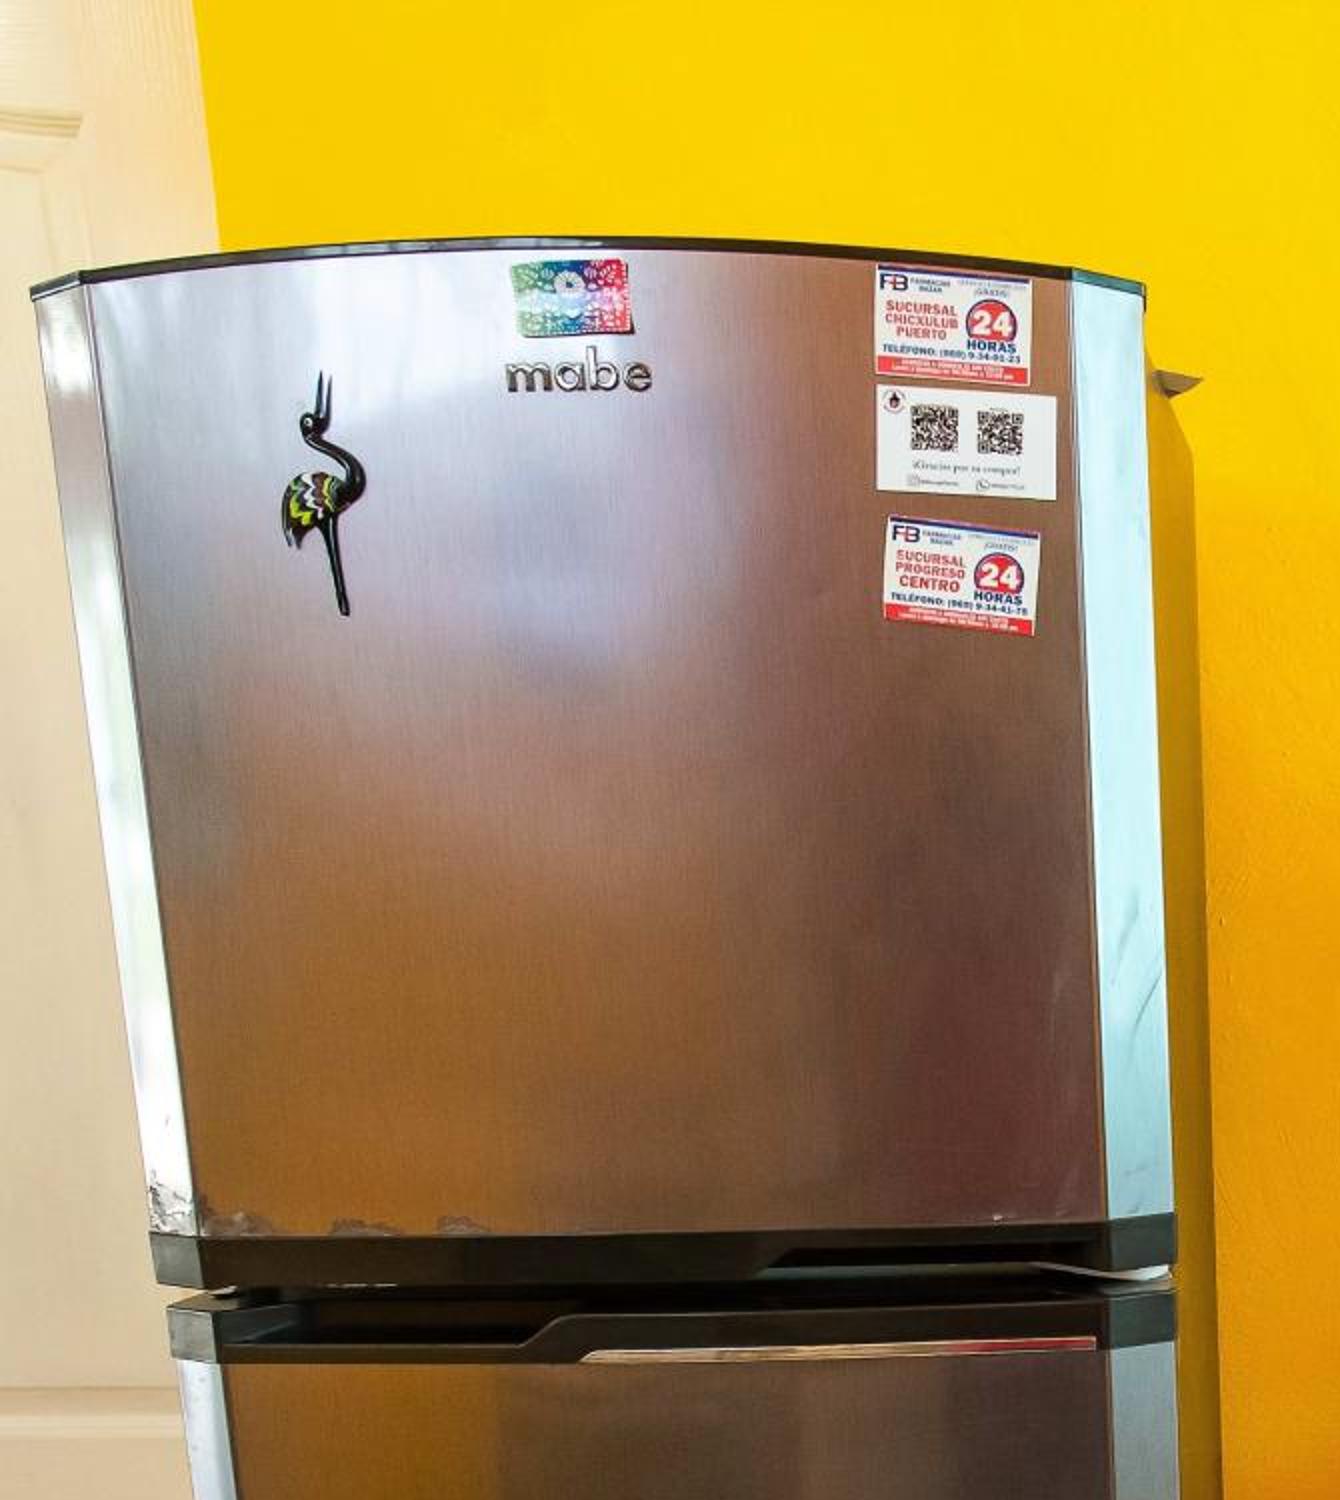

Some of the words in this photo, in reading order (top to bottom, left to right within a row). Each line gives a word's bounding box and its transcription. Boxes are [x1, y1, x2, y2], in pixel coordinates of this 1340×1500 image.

[880, 273, 908, 291] FB
[886, 300, 959, 317] SUCURSAL
[885, 313, 959, 330] CHICXULUB
[972, 309, 1014, 337] 24
[896, 327, 947, 341] PUERTO
[967, 340, 1017, 354] HORAS
[506, 345, 652, 392] mabe
[892, 525, 920, 543] FB
[896, 549, 966, 568] SUCURSAL
[895, 562, 965, 580] PROGRESO
[979, 561, 1020, 590] 24
[899, 575, 961, 593] CENTRO
[973, 591, 1023, 606] HORAS
